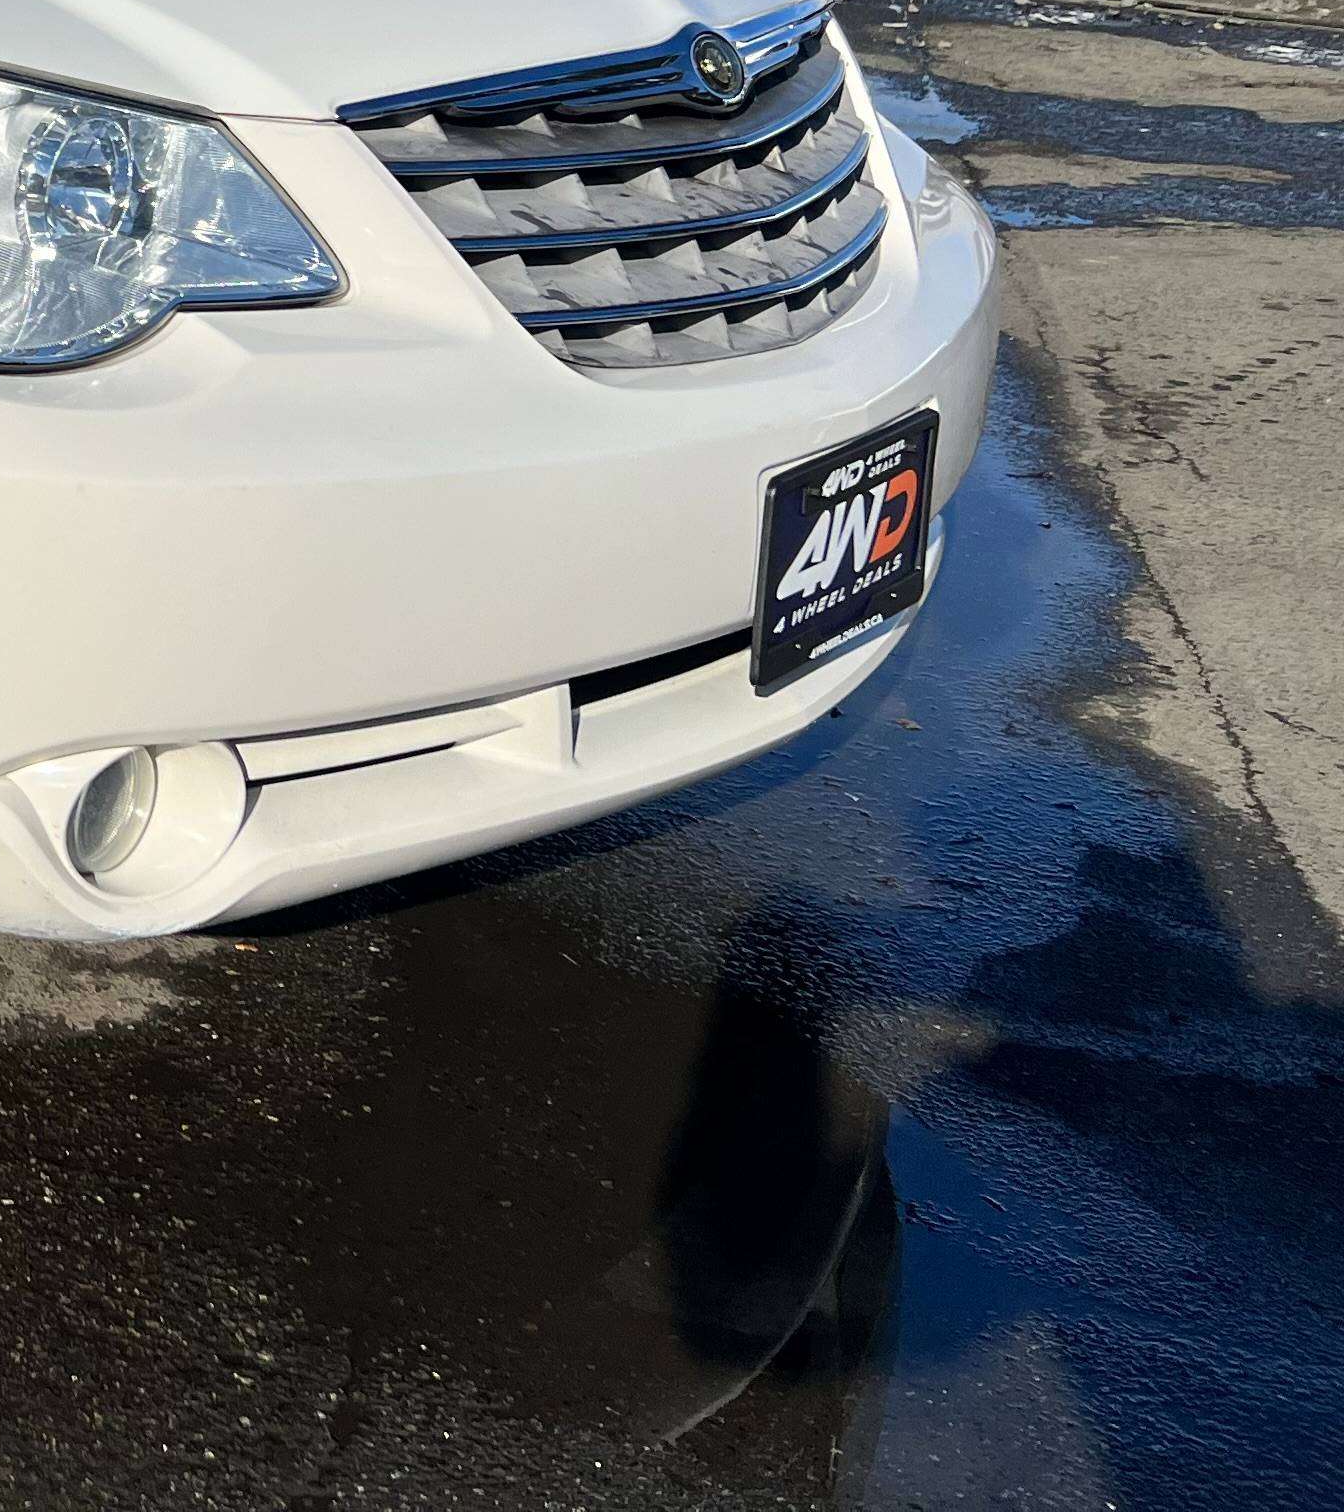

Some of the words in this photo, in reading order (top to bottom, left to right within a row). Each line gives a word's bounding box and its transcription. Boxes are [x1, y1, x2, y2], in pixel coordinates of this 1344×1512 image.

[822, 460, 865, 497] 4WD
[868, 453, 902, 478] DEALS
[776, 469, 918, 600] 4WD
[773, 616, 787, 633] 4
[791, 587, 846, 627] WHEEL
[852, 553, 903, 595] DEALS
